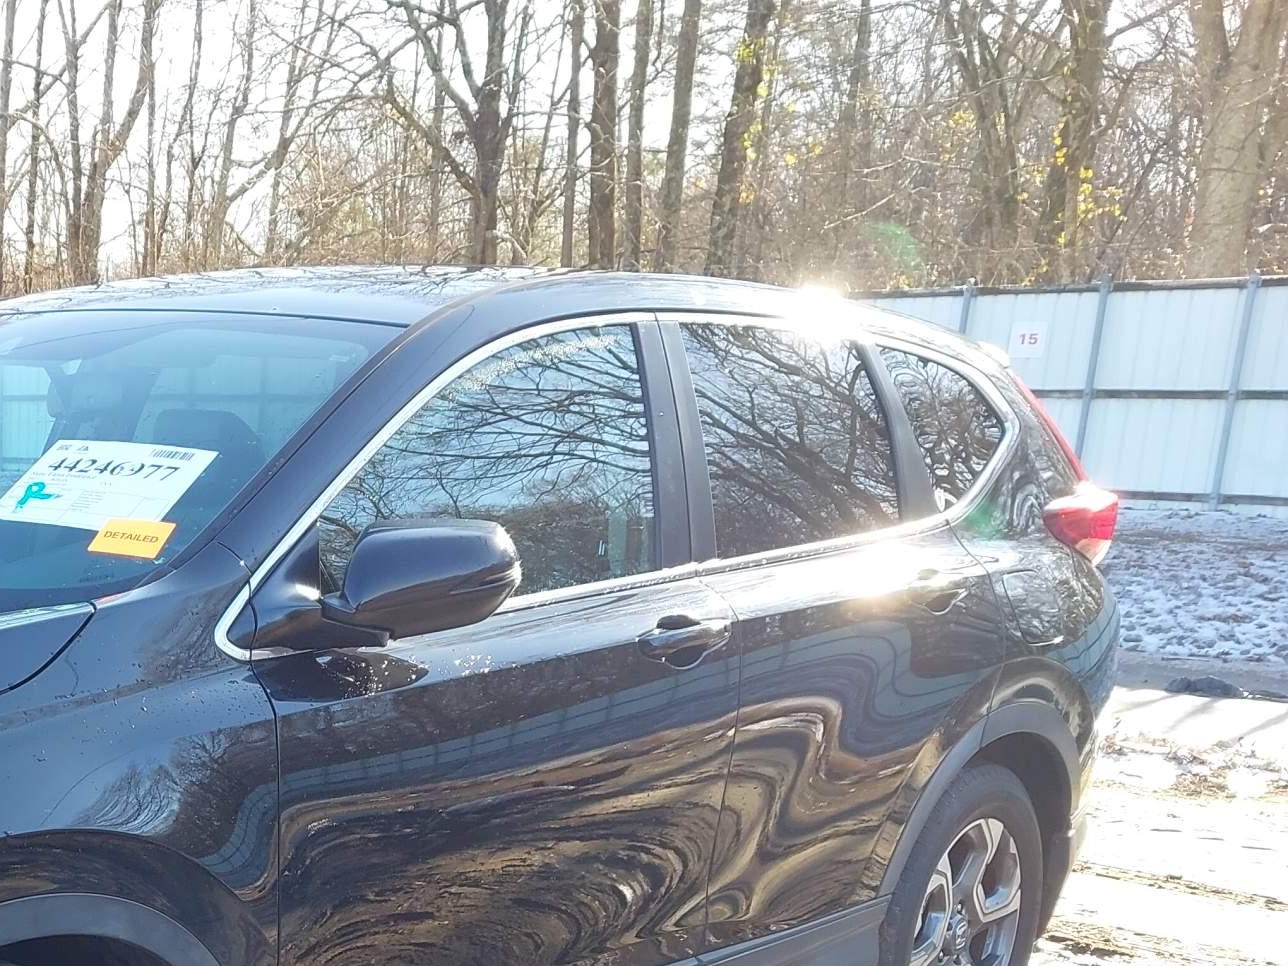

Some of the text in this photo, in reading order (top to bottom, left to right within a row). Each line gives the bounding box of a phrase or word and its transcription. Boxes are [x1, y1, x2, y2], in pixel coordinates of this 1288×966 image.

[1018, 332, 1039, 345] 15
[48, 457, 182, 481] 44246977
[103, 530, 159, 544] DETAILED
